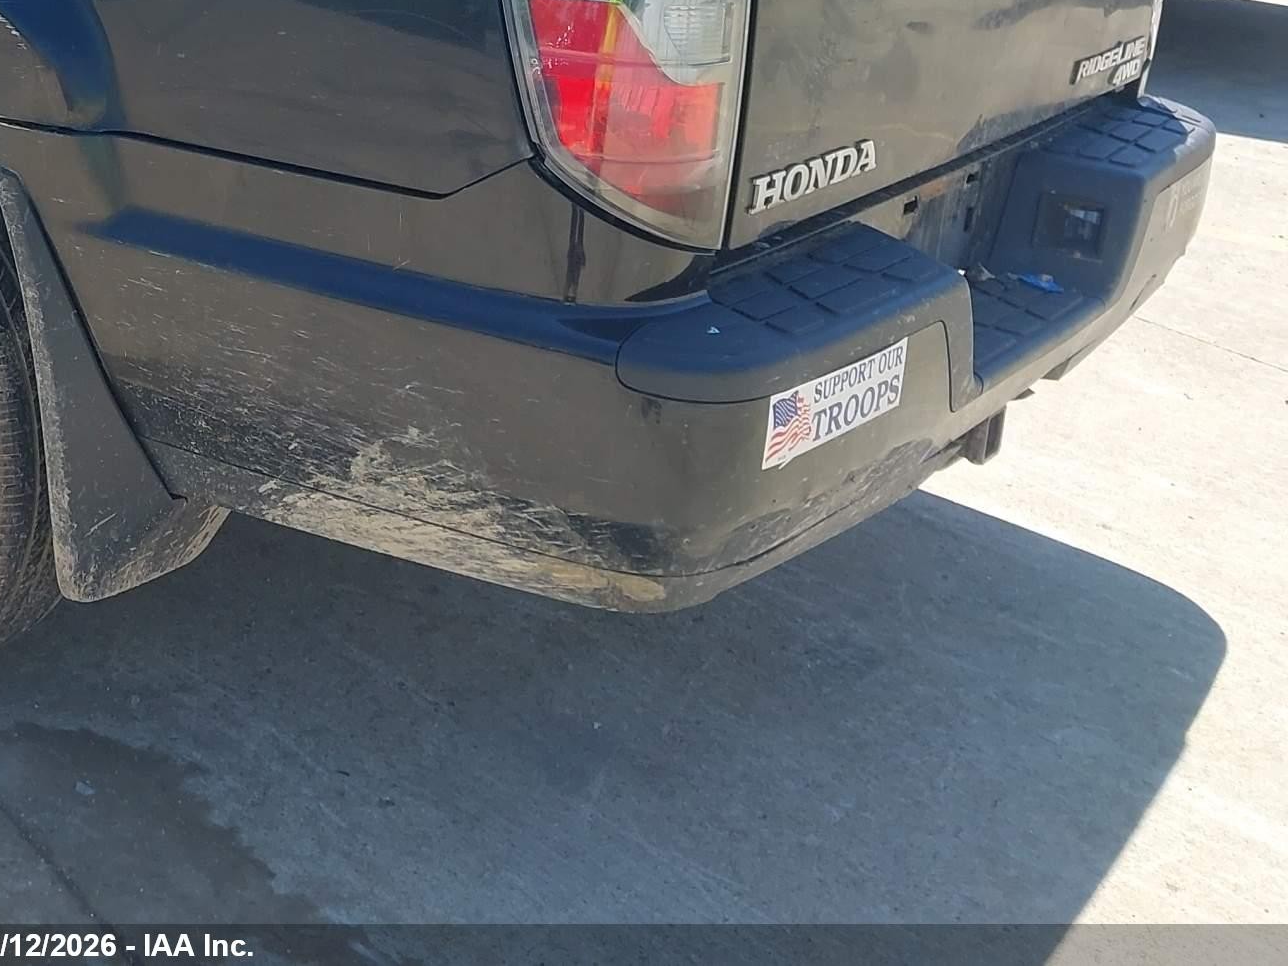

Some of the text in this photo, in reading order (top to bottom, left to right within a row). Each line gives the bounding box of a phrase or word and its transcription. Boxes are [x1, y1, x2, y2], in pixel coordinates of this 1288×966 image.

[1071, 36, 1146, 84] RIDGELINE
[747, 139, 877, 215] HONDA
[813, 345, 904, 404] SUPPORT OUR
[812, 374, 900, 442] TROOPS
